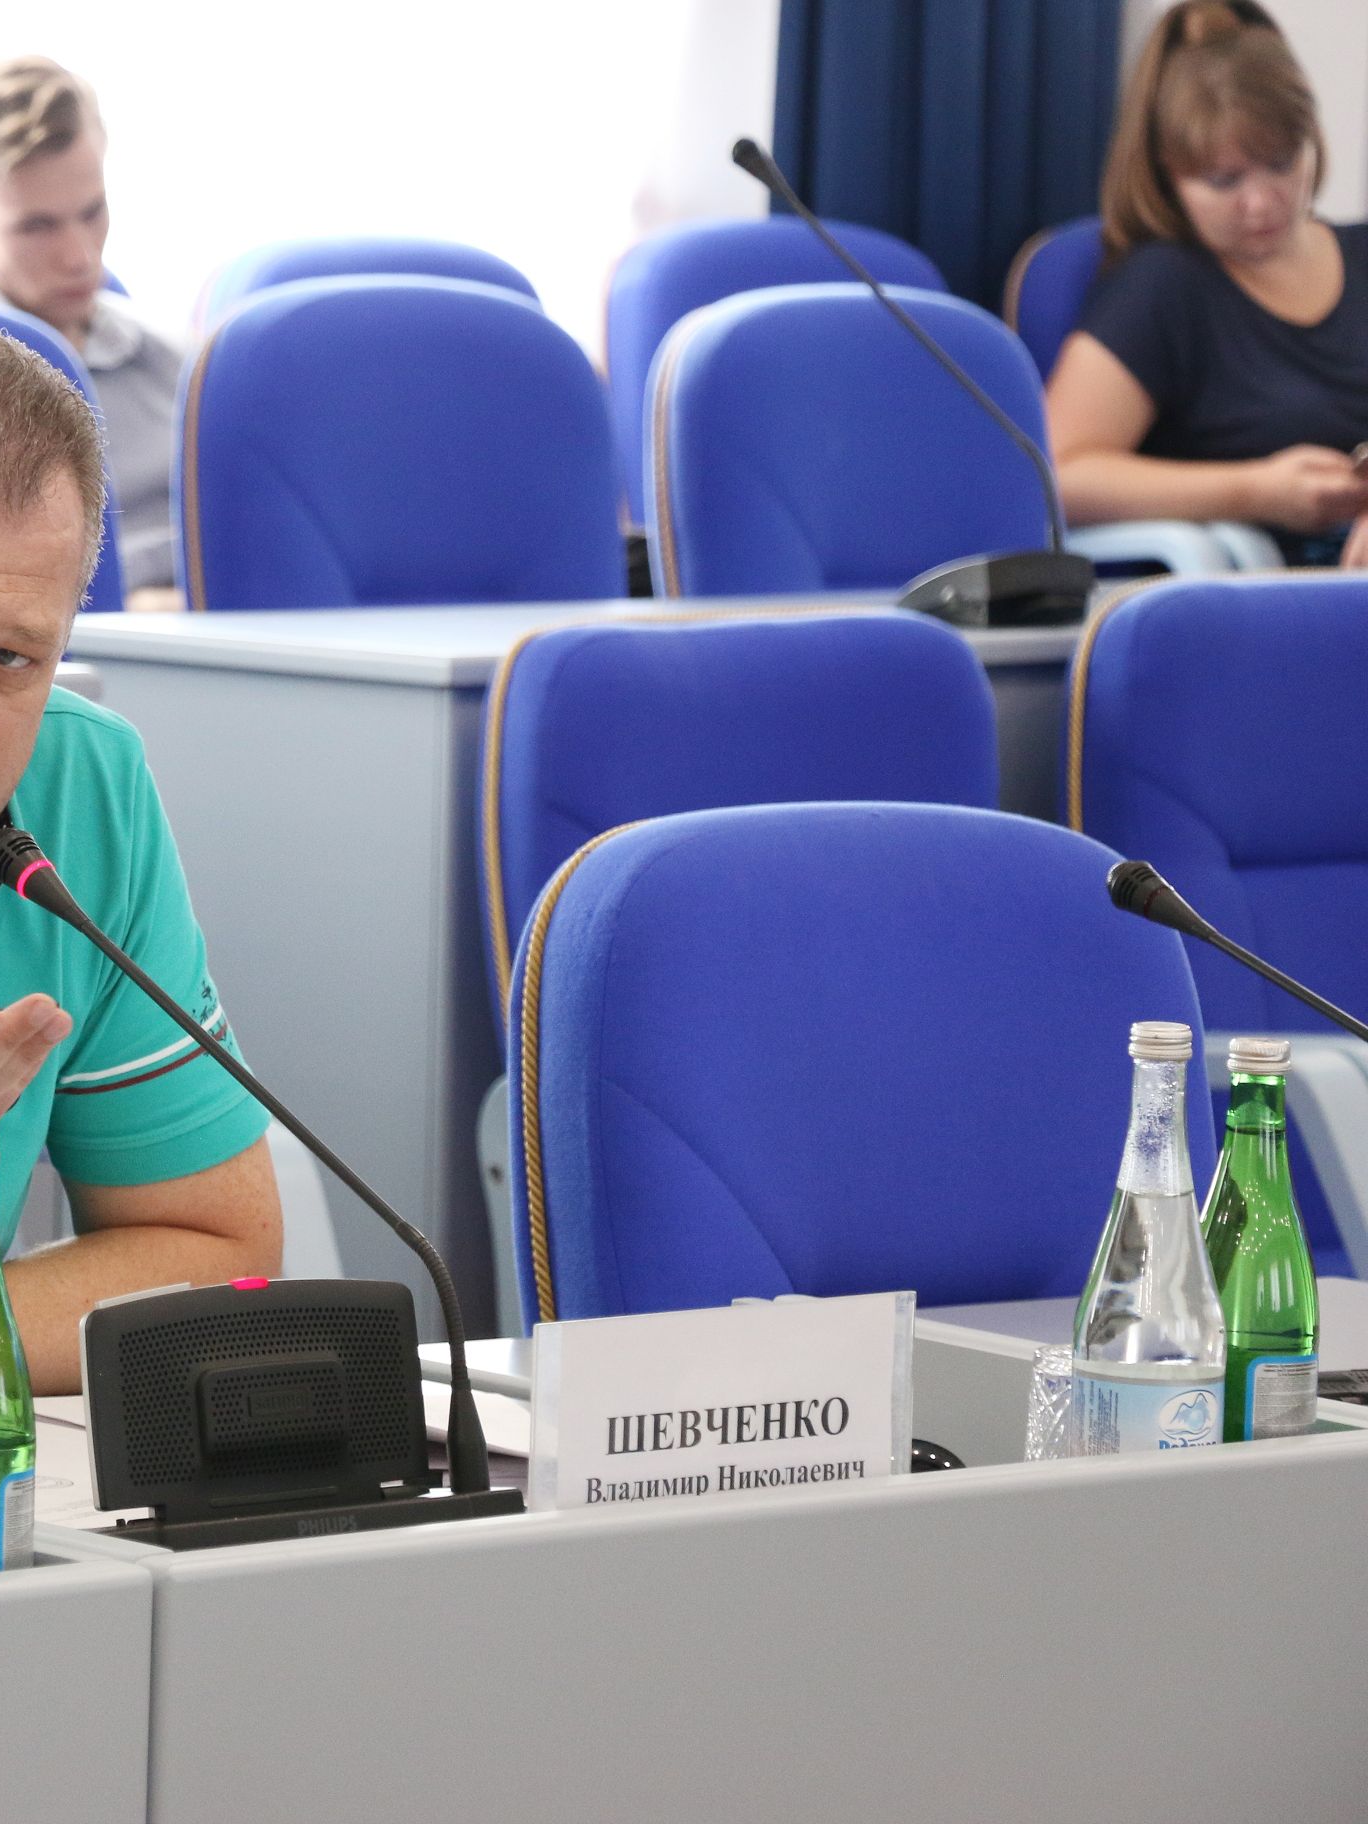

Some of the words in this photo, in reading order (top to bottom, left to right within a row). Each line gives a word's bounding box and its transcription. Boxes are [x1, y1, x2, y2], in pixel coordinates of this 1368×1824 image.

[606, 1396, 850, 1456] ШЕВЧЕНКО
[586, 1473, 709, 1503] Владимир
[718, 1459, 866, 1491] Николаевич
[298, 1515, 357, 1536] PHILIPS
